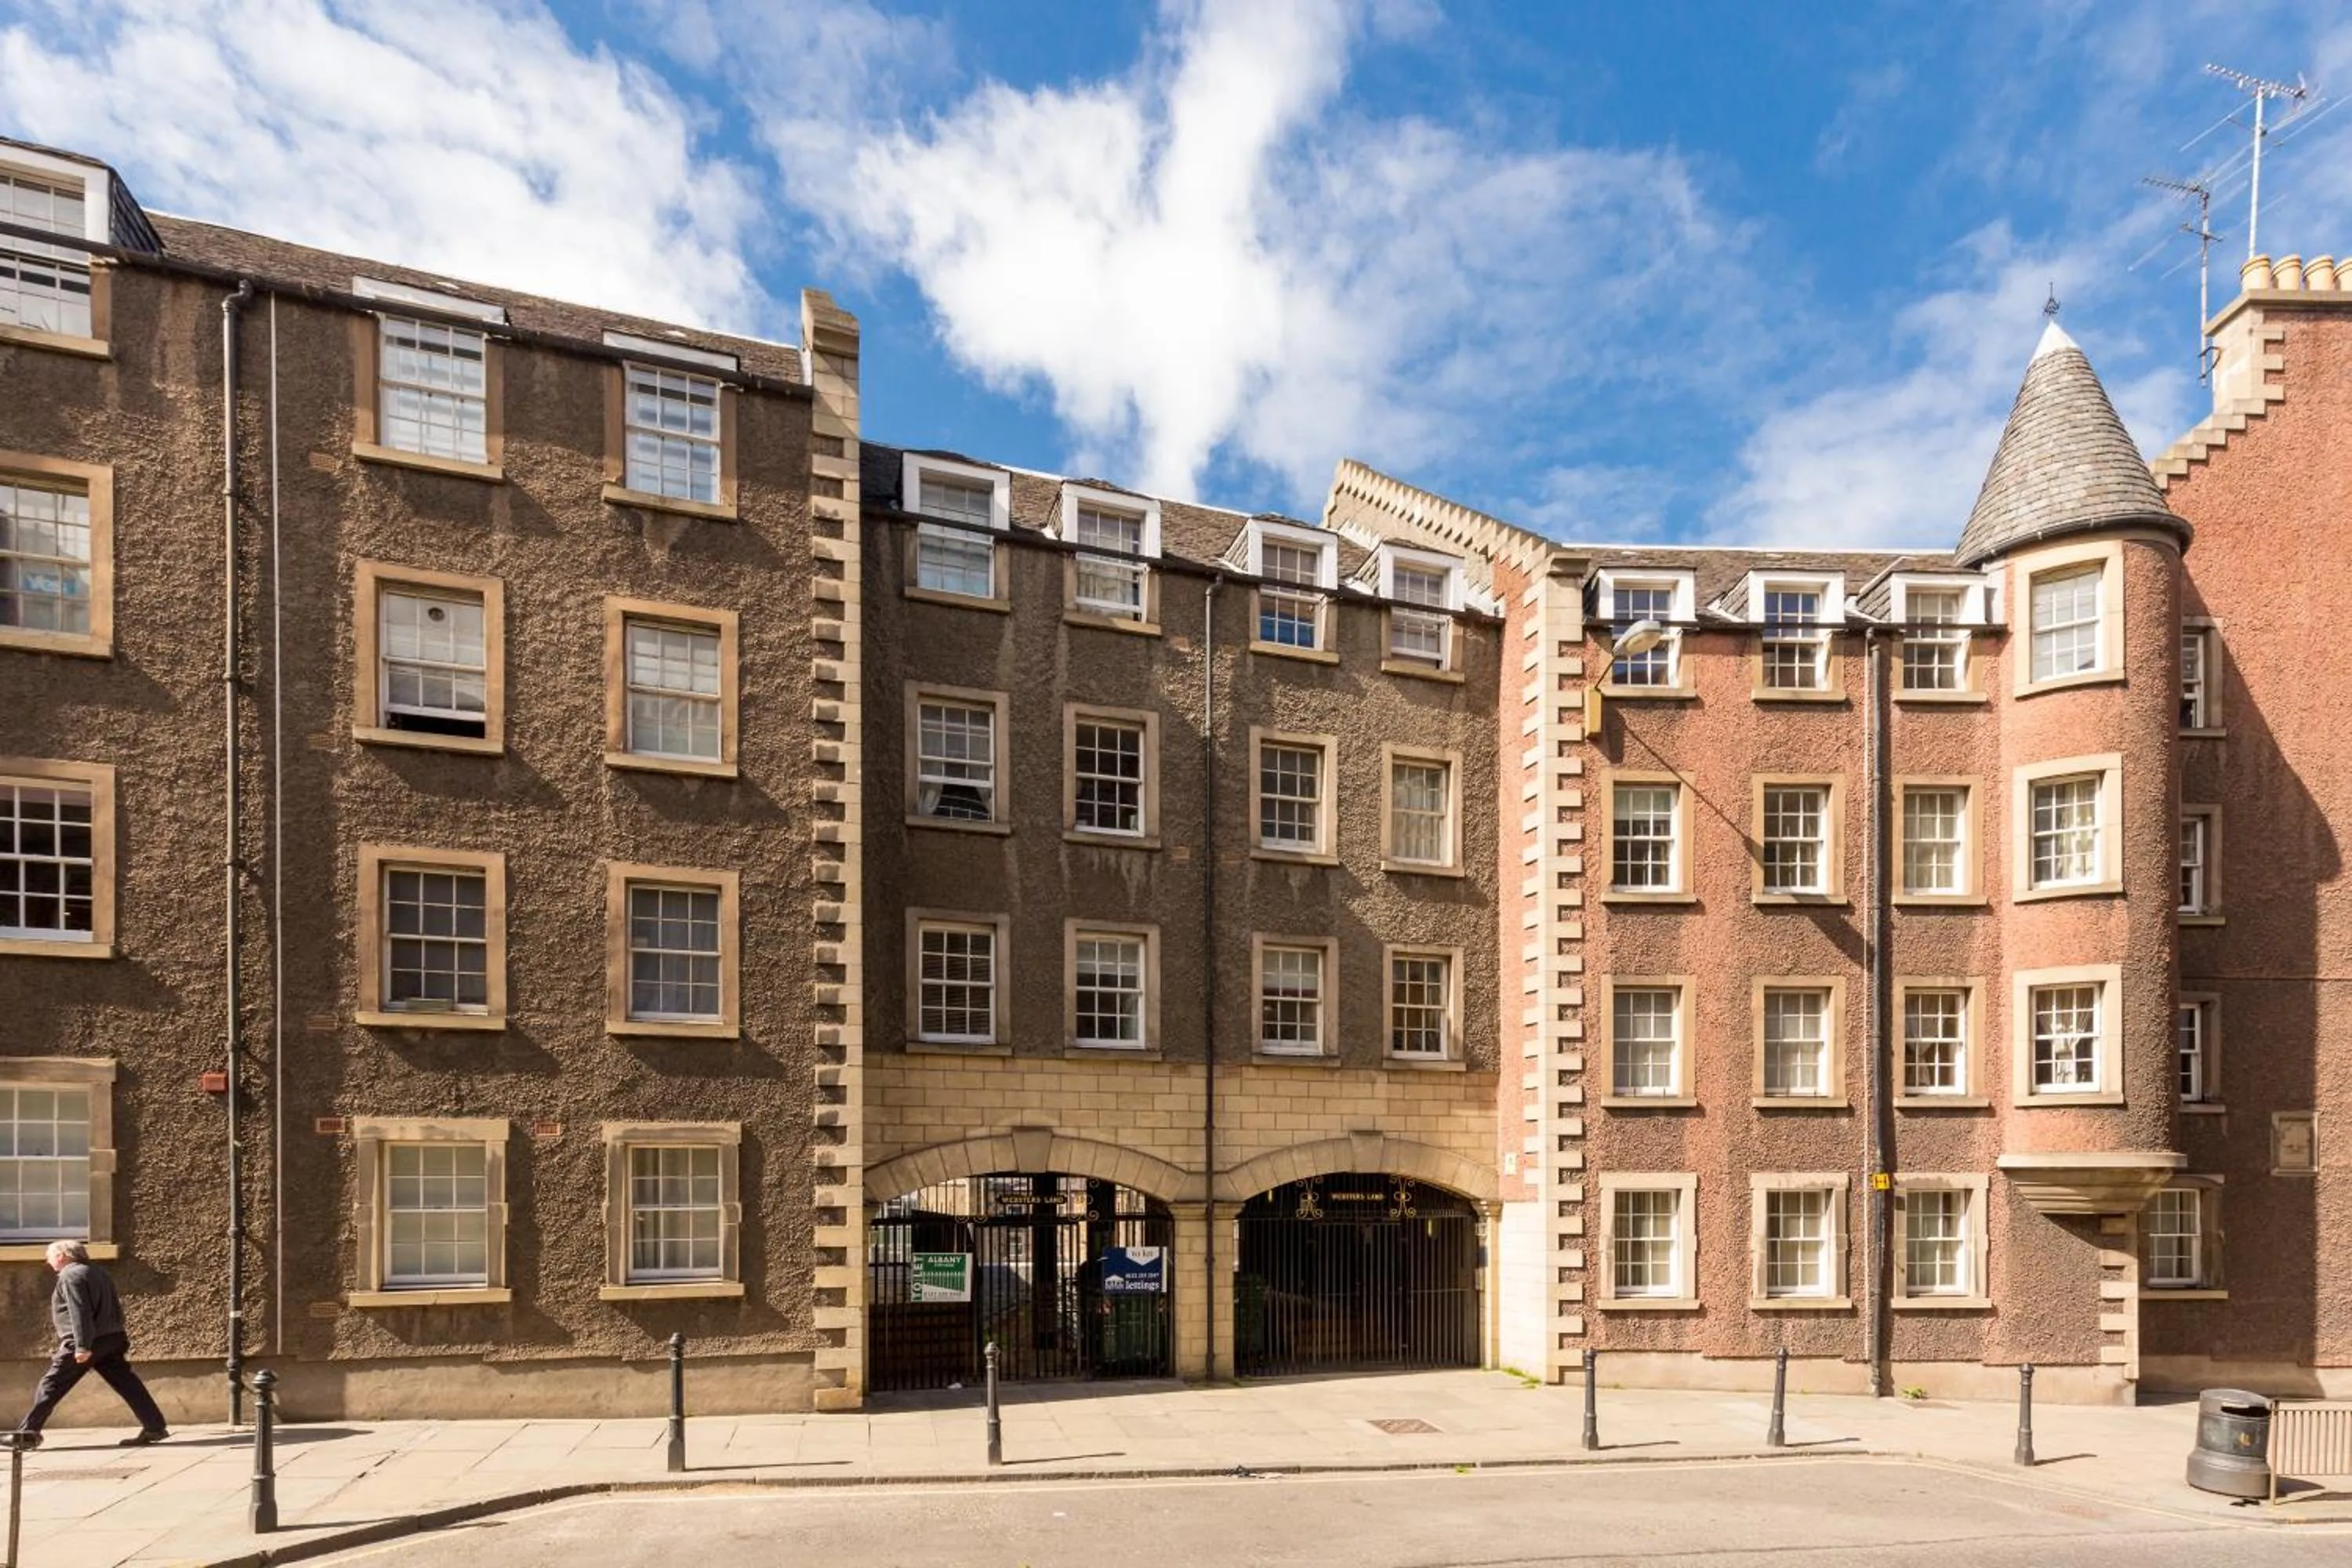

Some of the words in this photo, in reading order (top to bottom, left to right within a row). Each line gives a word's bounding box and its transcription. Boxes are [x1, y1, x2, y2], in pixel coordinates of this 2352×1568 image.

[913, 1254, 923, 1277] LET
[913, 1282, 923, 1300] TO
[1125, 1279, 1160, 1291] lettings
